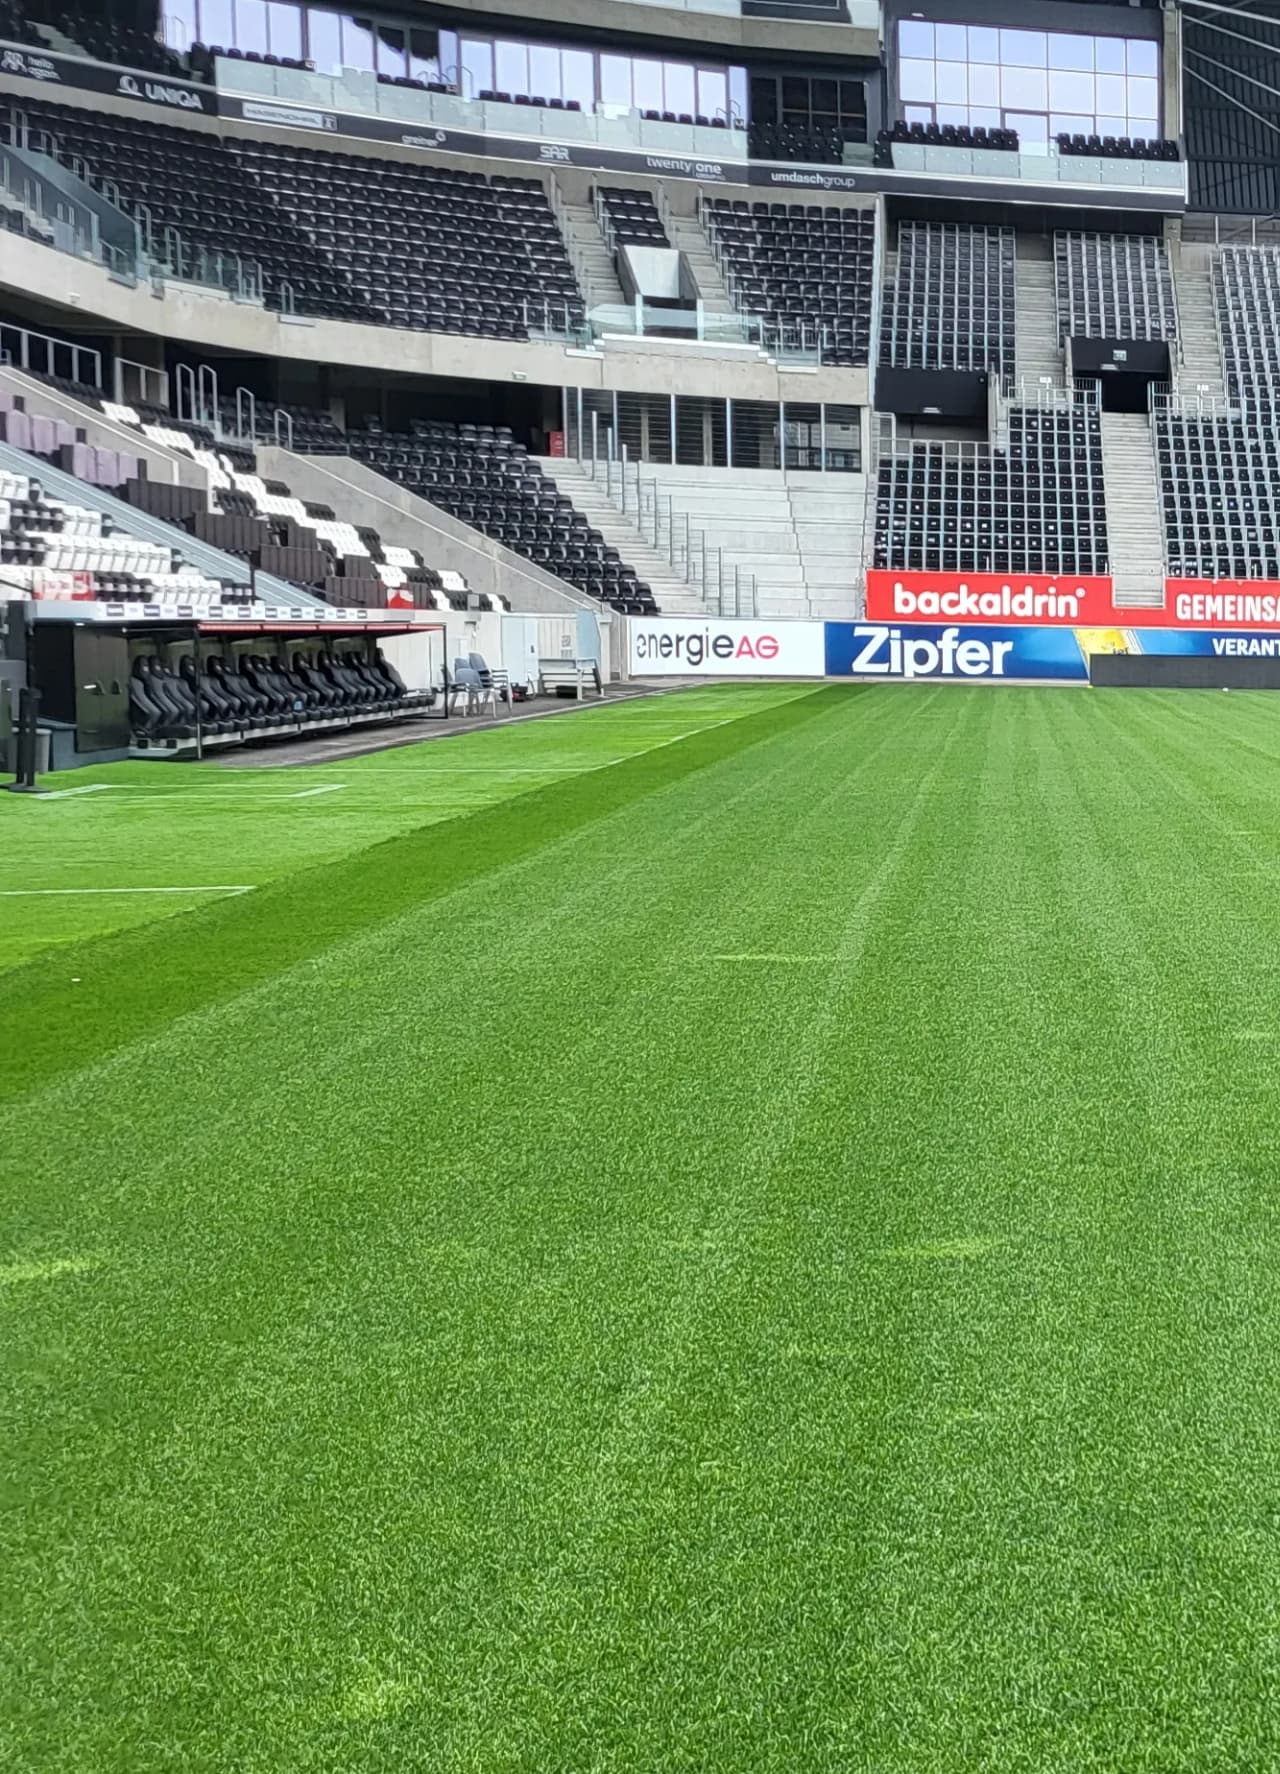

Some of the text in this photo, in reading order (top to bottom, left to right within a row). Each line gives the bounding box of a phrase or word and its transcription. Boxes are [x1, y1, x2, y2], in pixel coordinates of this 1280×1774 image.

[145, 82, 203, 109] UNIQA
[540, 145, 570, 160] SAR
[647, 157, 721, 174] twenty one
[771, 172, 855, 188] umdaschgroup
[894, 582, 1078, 618] backaldrin
[636, 627, 780, 666] energieAG
[852, 626, 1014, 677] Zipfer
